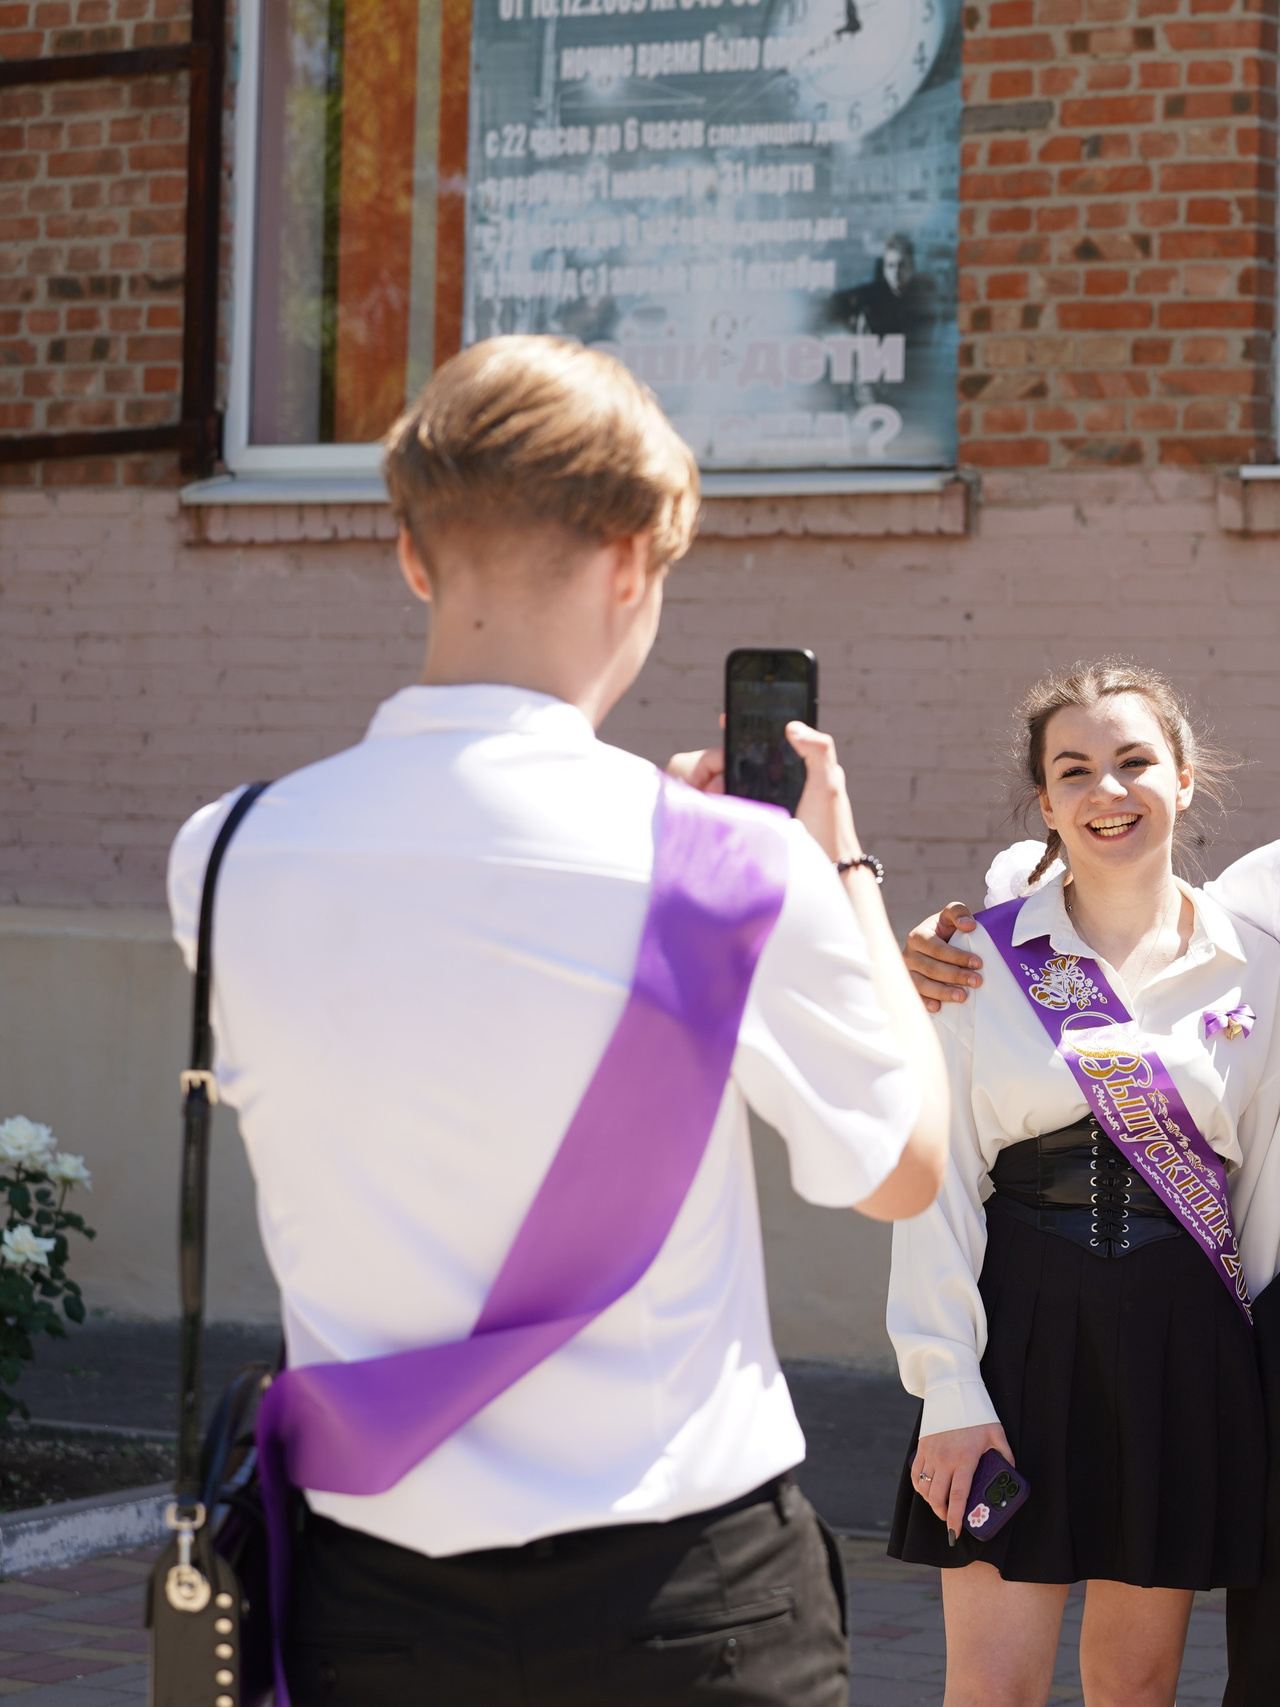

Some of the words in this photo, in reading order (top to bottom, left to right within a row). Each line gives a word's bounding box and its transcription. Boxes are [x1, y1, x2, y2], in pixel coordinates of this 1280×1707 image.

[703, 32, 760, 73] было
[485, 130, 498, 159] с
[502, 125, 529, 158] 22
[530, 126, 592, 158] часов
[593, 124, 622, 158] до
[624, 117, 639, 152] 6
[642, 119, 706, 150] часов
[738, 333, 906, 389] дети
